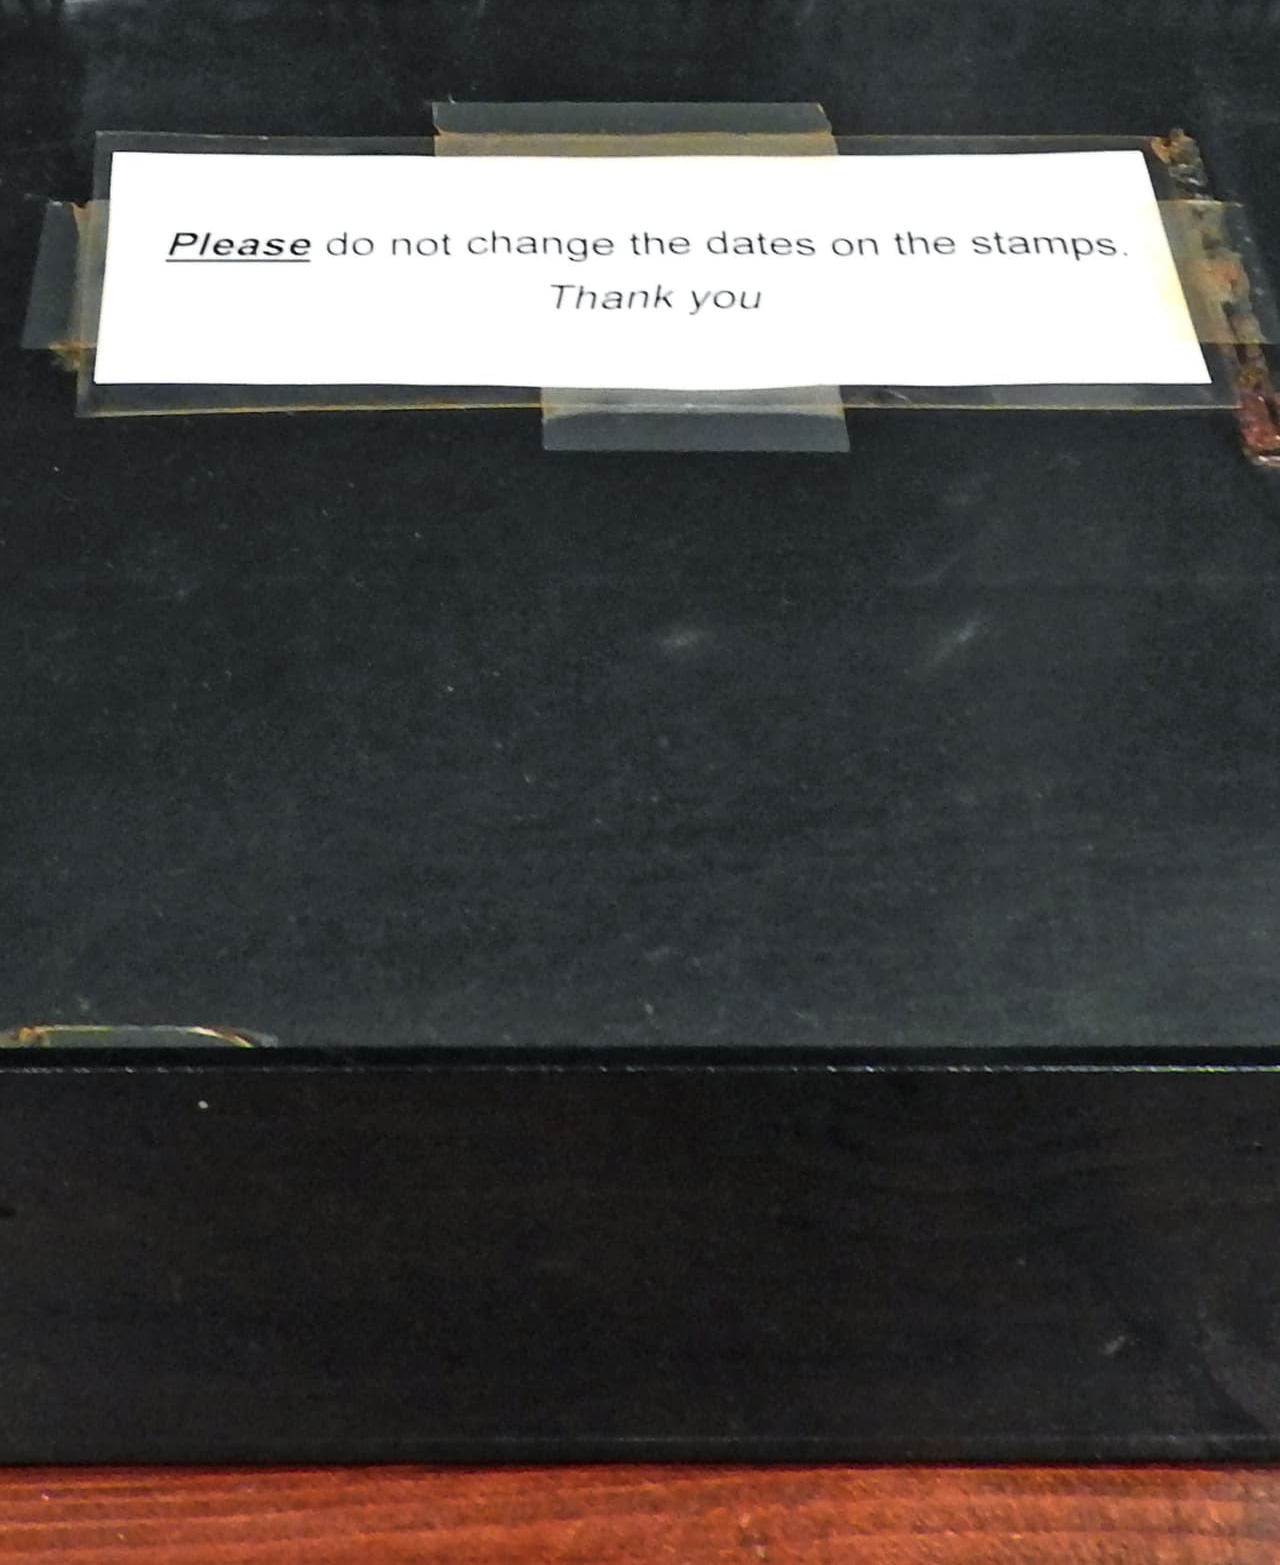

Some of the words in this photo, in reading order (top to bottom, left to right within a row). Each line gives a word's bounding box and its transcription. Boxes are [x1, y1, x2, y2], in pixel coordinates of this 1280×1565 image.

[166, 232, 312, 262] Please
[326, 232, 375, 256] do
[392, 234, 452, 256] not
[467, 231, 615, 262] change
[630, 233, 691, 256] the
[706, 231, 817, 256] dates
[831, 235, 879, 257] on
[894, 233, 956, 256] the
[971, 232, 1129, 261] stamps.
[550, 284, 674, 310] Thank
[689, 290, 762, 315] you
